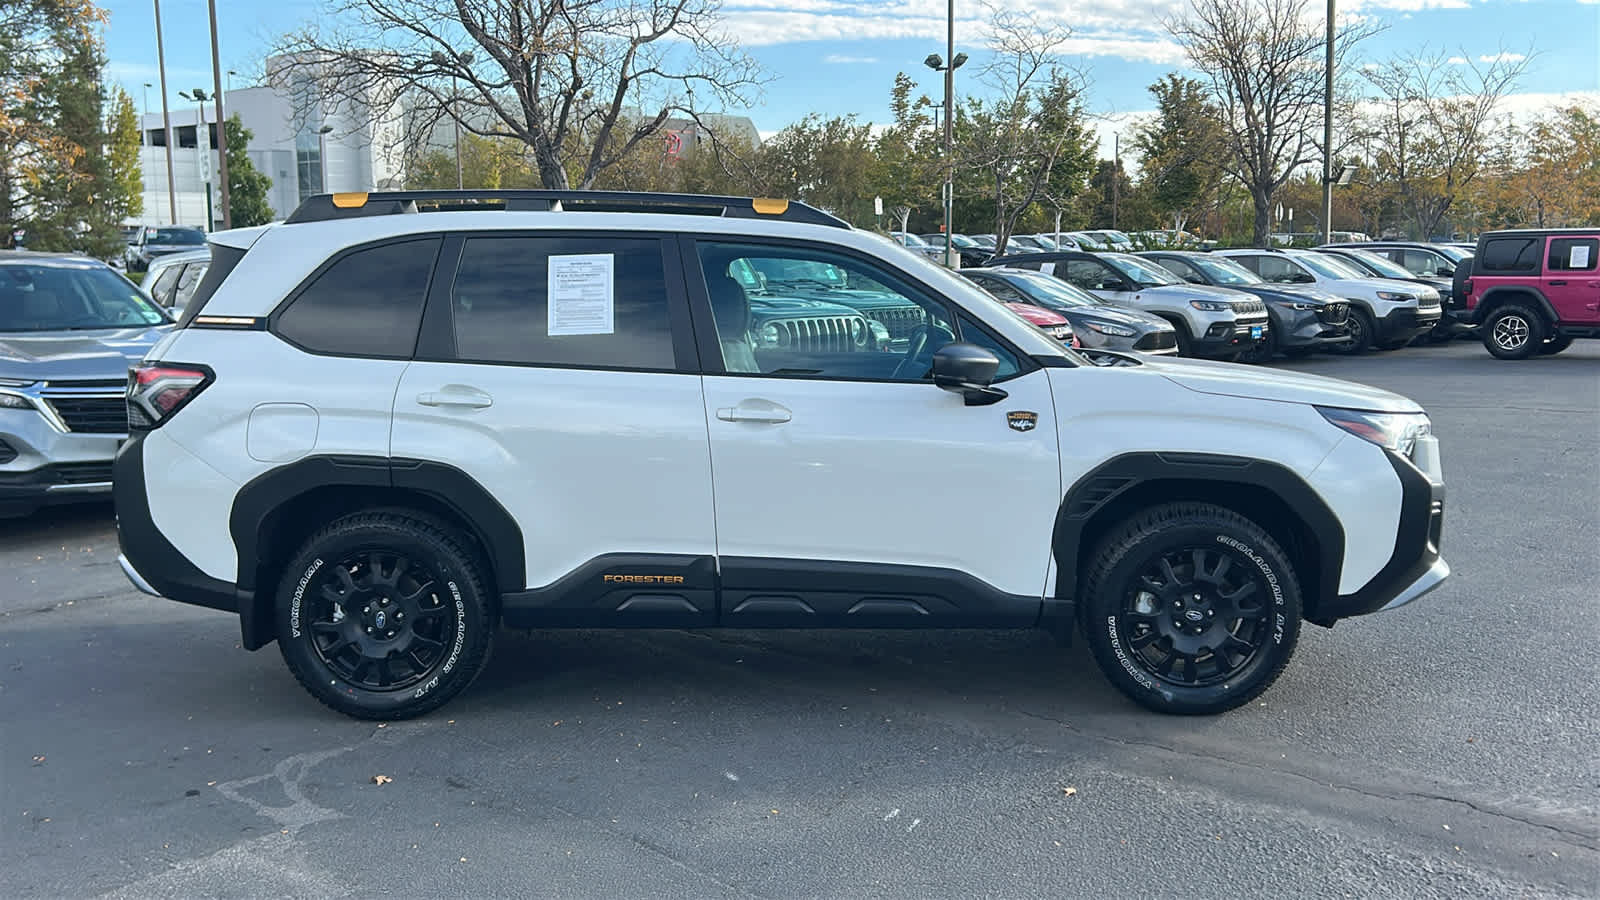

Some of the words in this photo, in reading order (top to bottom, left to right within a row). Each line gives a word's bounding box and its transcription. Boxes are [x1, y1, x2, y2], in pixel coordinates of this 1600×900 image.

[290, 558, 324, 638] YOKOHAMA
[604, 574, 684, 584] FORESTER
[1216, 535, 1285, 606] GEOLANDAR
[1272, 612, 1285, 644] A/T
[442, 581, 466, 674] GEOLANDAR
[1107, 615, 1152, 689] YOKOHAMA
[414, 676, 440, 698] A/T
